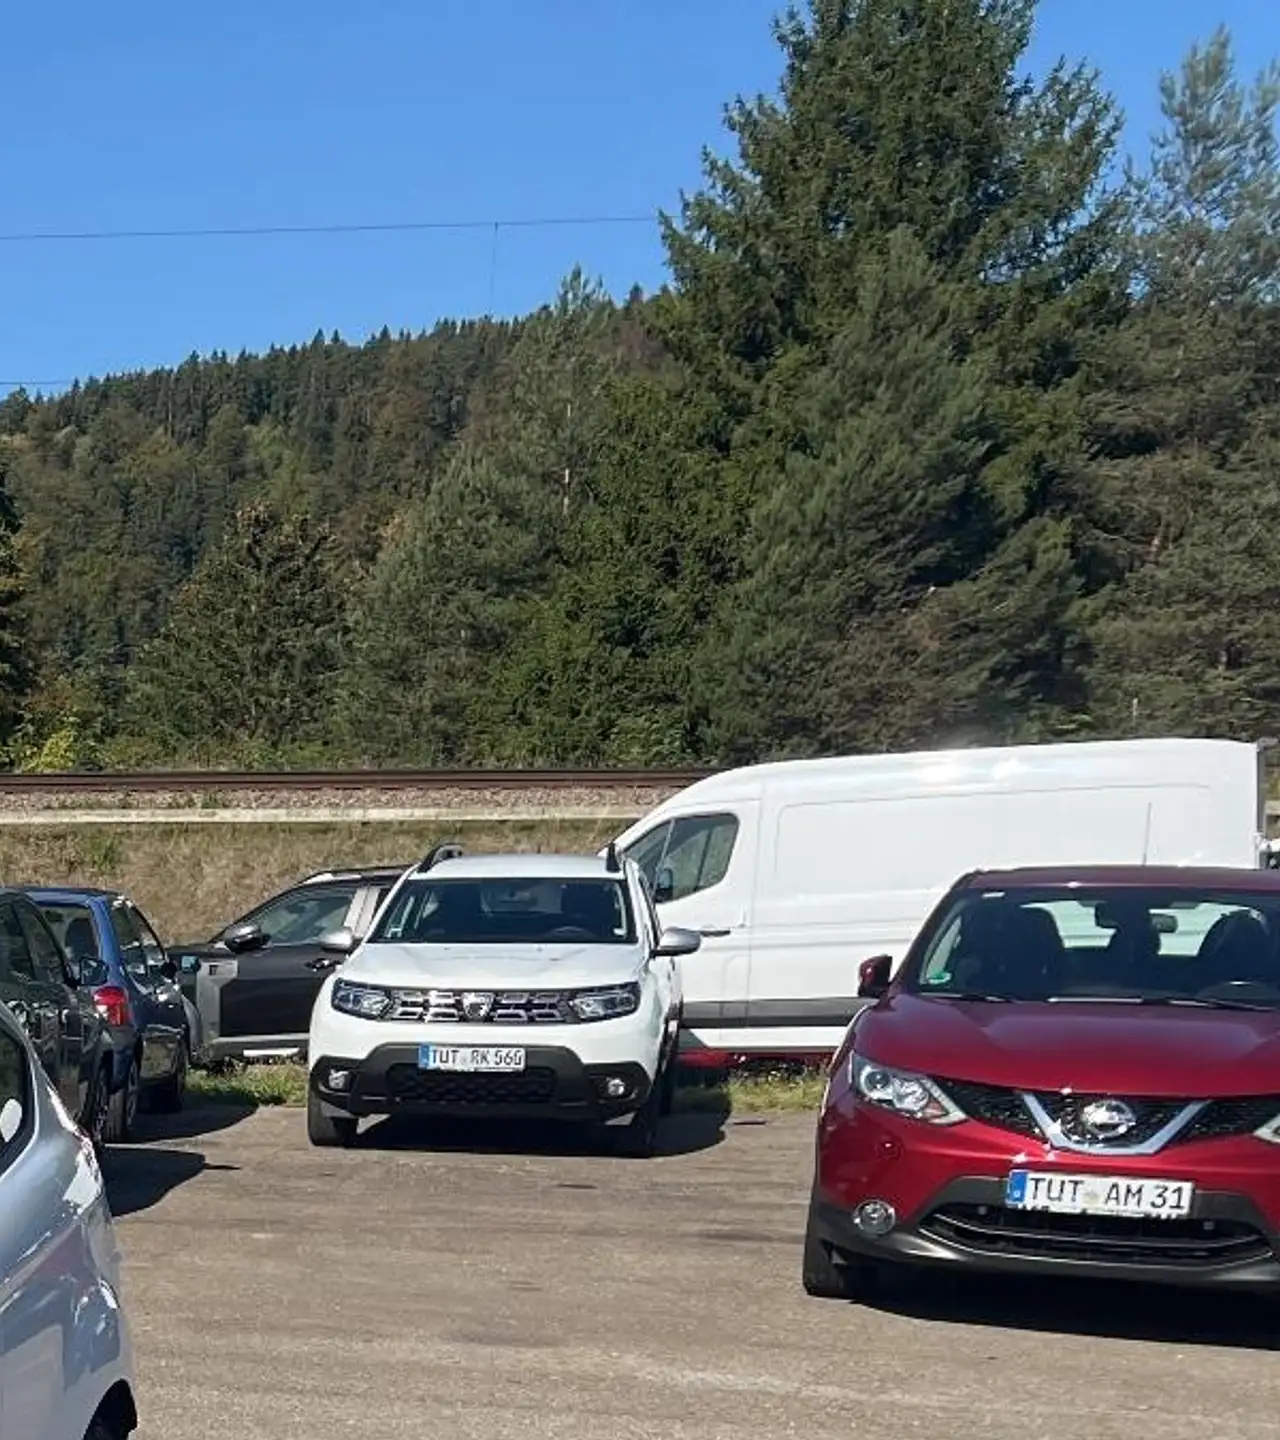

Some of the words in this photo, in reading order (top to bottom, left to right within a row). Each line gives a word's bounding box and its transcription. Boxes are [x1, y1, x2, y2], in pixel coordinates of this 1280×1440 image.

[432, 1049, 460, 1064] TUT
[470, 1049, 490, 1065] RK
[494, 1049, 523, 1066] 560
[1029, 1176, 1085, 1203] TUT
[1104, 1182, 1145, 1209] AM
[1149, 1184, 1185, 1210] 31
